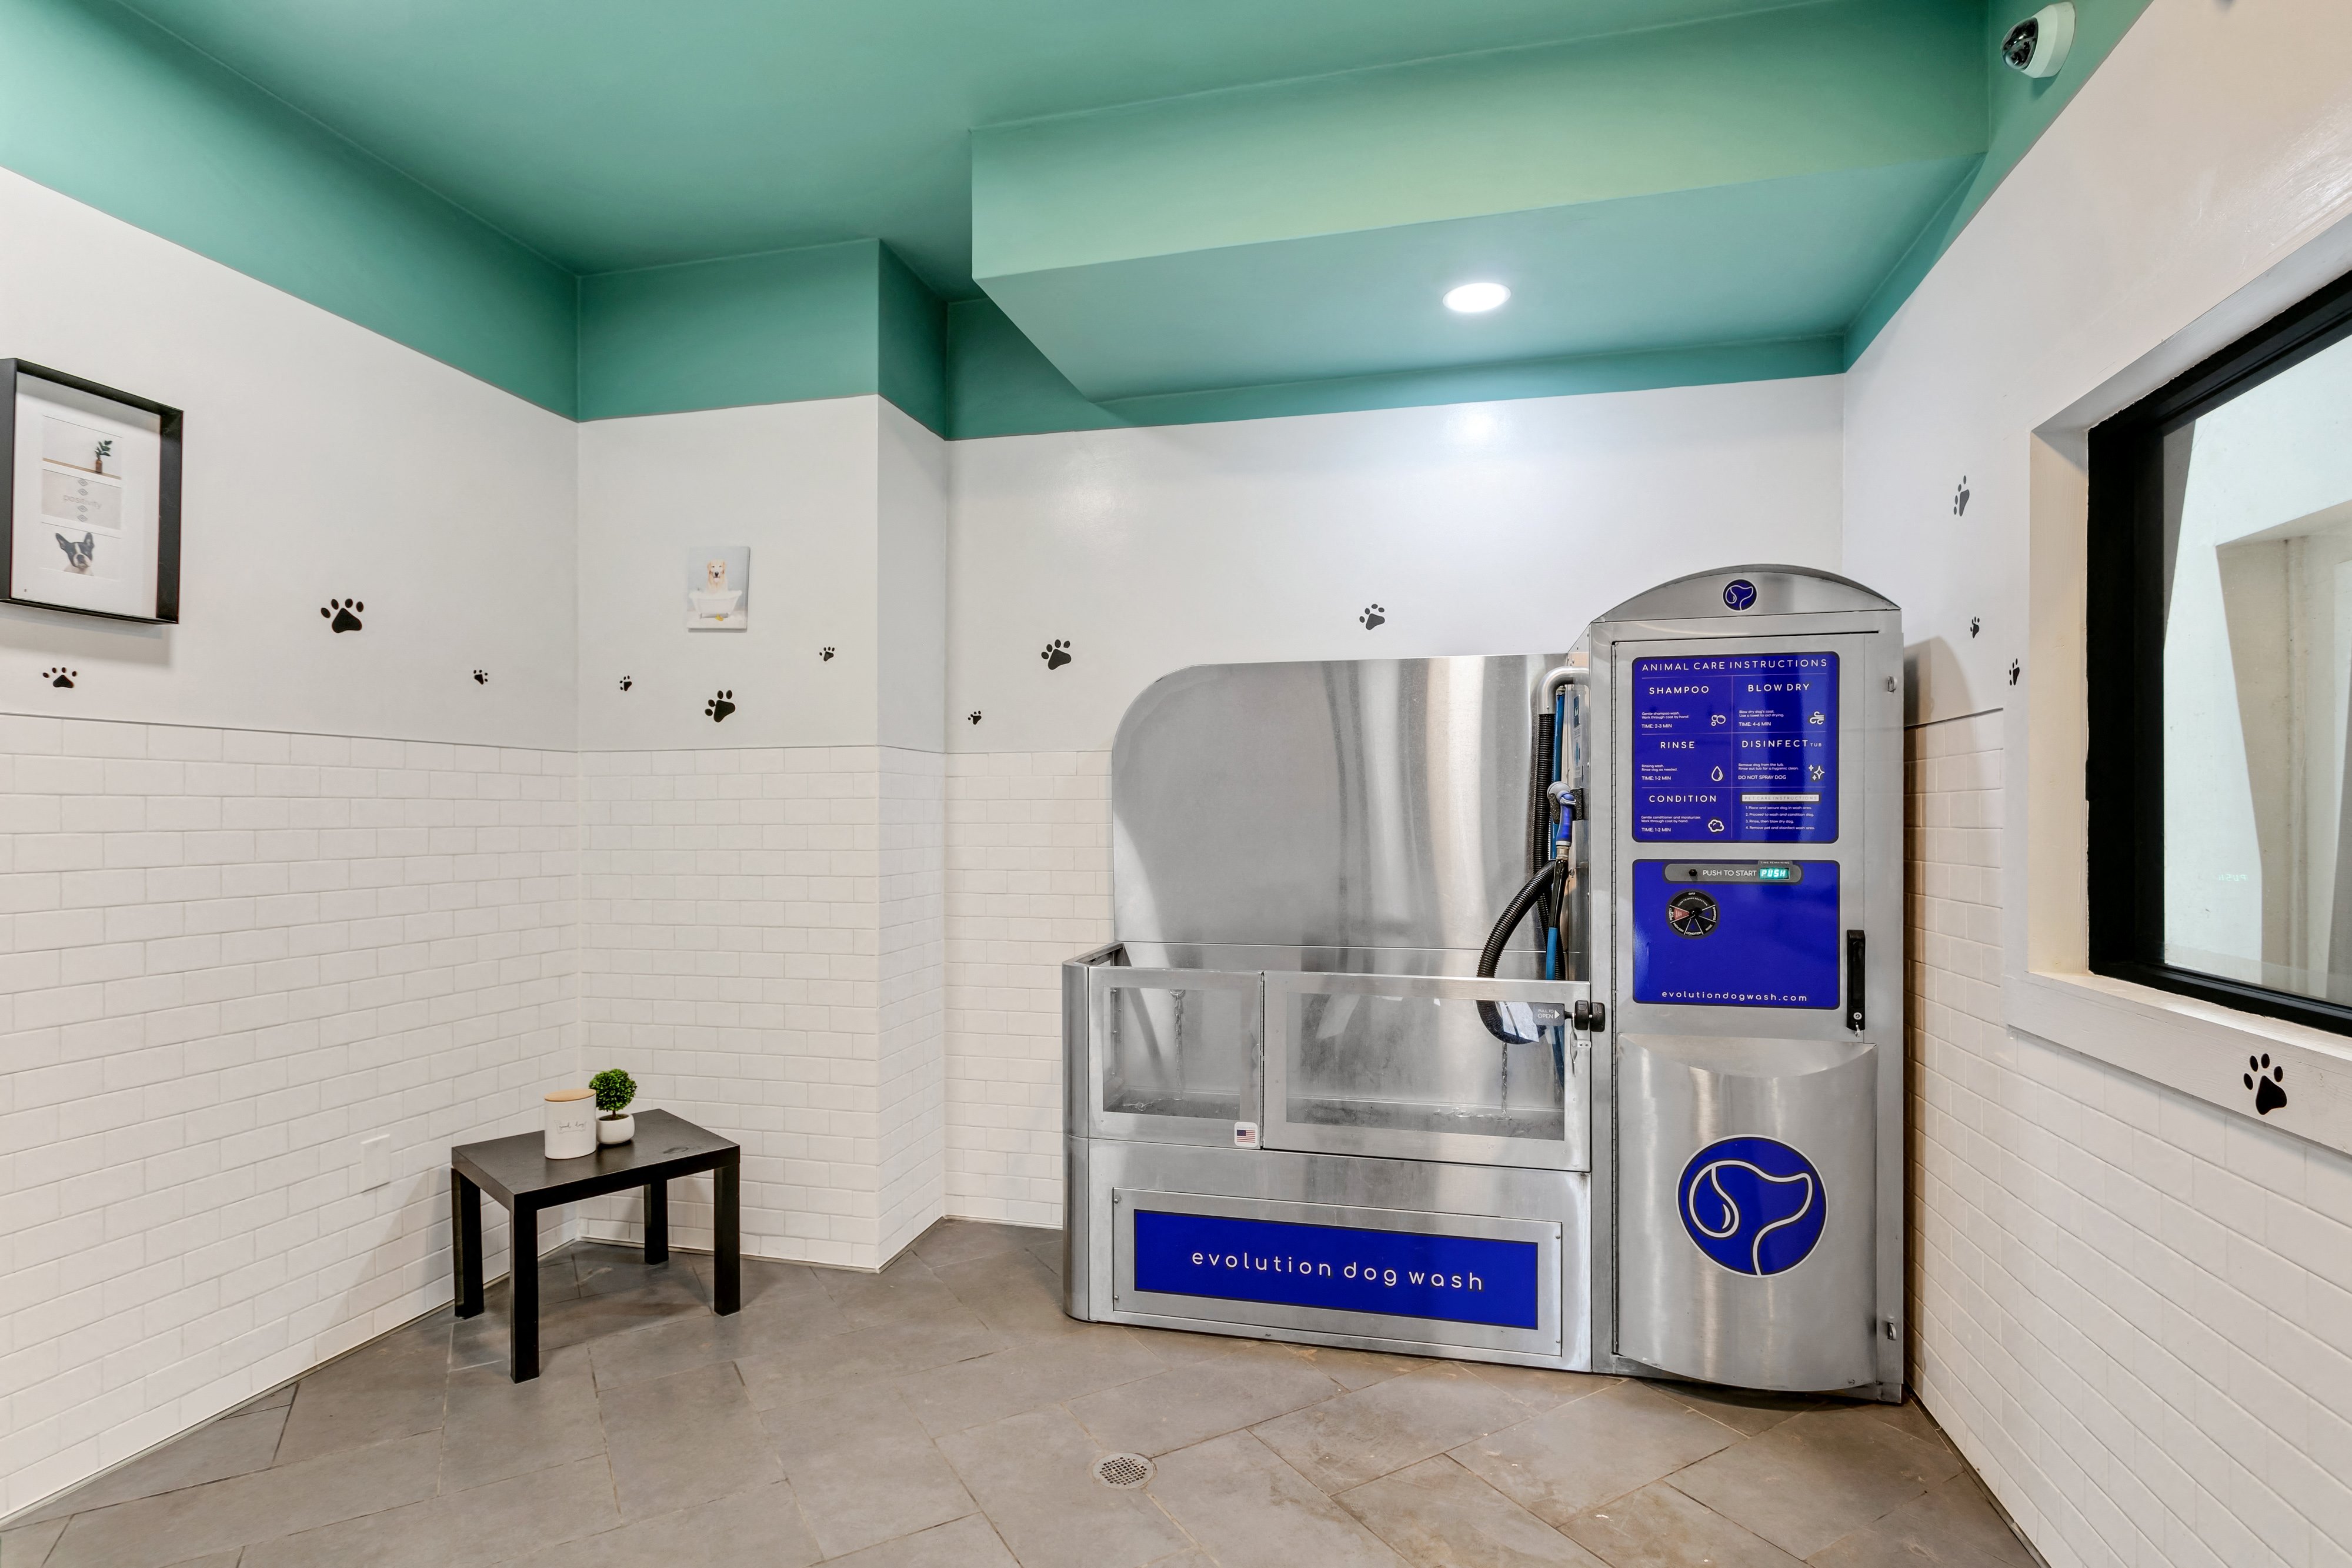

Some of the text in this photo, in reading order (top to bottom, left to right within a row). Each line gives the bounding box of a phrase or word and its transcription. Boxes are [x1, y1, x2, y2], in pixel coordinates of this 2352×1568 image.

[1730, 659, 1827, 668] INSTRUCTIONS
[1649, 686, 1709, 694] SHAMPOO
[1662, 991, 1807, 1001] evolutiondogwash.com
[1192, 1252, 1482, 1290] evolution dog wash
